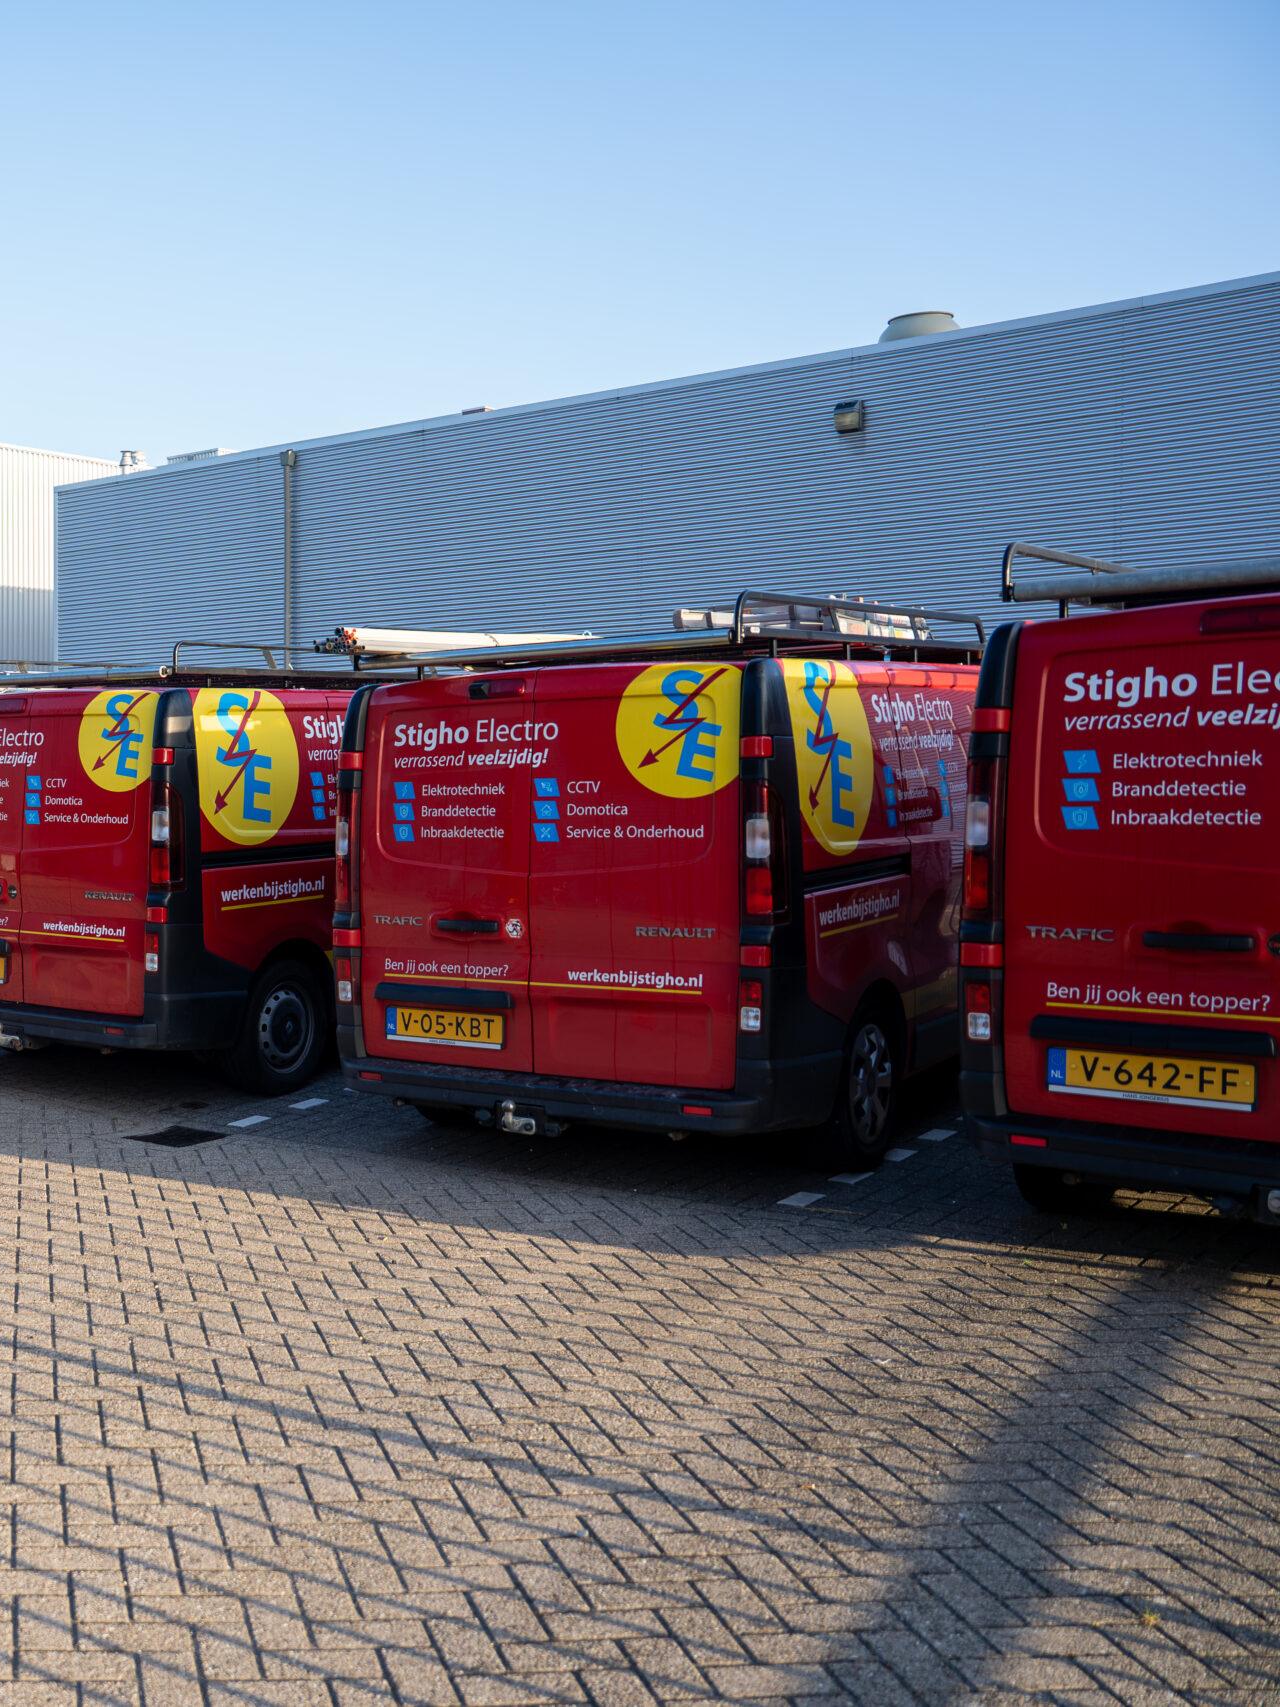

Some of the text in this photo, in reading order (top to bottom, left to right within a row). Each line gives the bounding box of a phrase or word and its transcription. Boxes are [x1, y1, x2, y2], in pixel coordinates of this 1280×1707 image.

[1063, 667, 1198, 708] Stigho
[871, 692, 953, 731] Stigho Electro
[1064, 705, 1190, 731] verrassend
[394, 718, 559, 751] Stigho Electro
[394, 748, 549, 769] verrassend veelzijdig!
[1112, 750, 1263, 769] Elektrotechniek
[46, 778, 67, 789] CCTV
[422, 783, 505, 797] Elektrotechniek
[567, 781, 601, 794] CCTV
[1112, 780, 1247, 797] Branddetectie
[45, 796, 83, 806] Domotica
[566, 803, 629, 816] Domotica
[44, 812, 129, 825] Service & Onderhoud
[421, 805, 496, 818] Branddetectie
[1111, 808, 1262, 826] Inbraakdetectie
[421, 825, 505, 839] Inbraakdetectie
[566, 825, 705, 839] Service & Onderhoud
[221, 875, 325, 903] werkenbijstigho.nl
[819, 889, 900, 927] werkenbijstigho.nl
[372, 914, 423, 926] TRAFIC
[43, 921, 126, 938] werkenbijstigho.nl
[635, 926, 716, 939] RENAULT
[1025, 925, 1115, 942] TRAFIC
[384, 958, 509, 978] Ben jij ook een topper?
[568, 969, 703, 989] werkenbijstigho.nl
[1046, 982, 1271, 1013] Ben jij ook een topper?
[401, 1012, 495, 1039] V-05-KBT
[1050, 1070, 1064, 1079] NL
[1080, 1055, 1240, 1095] V-642-FF
